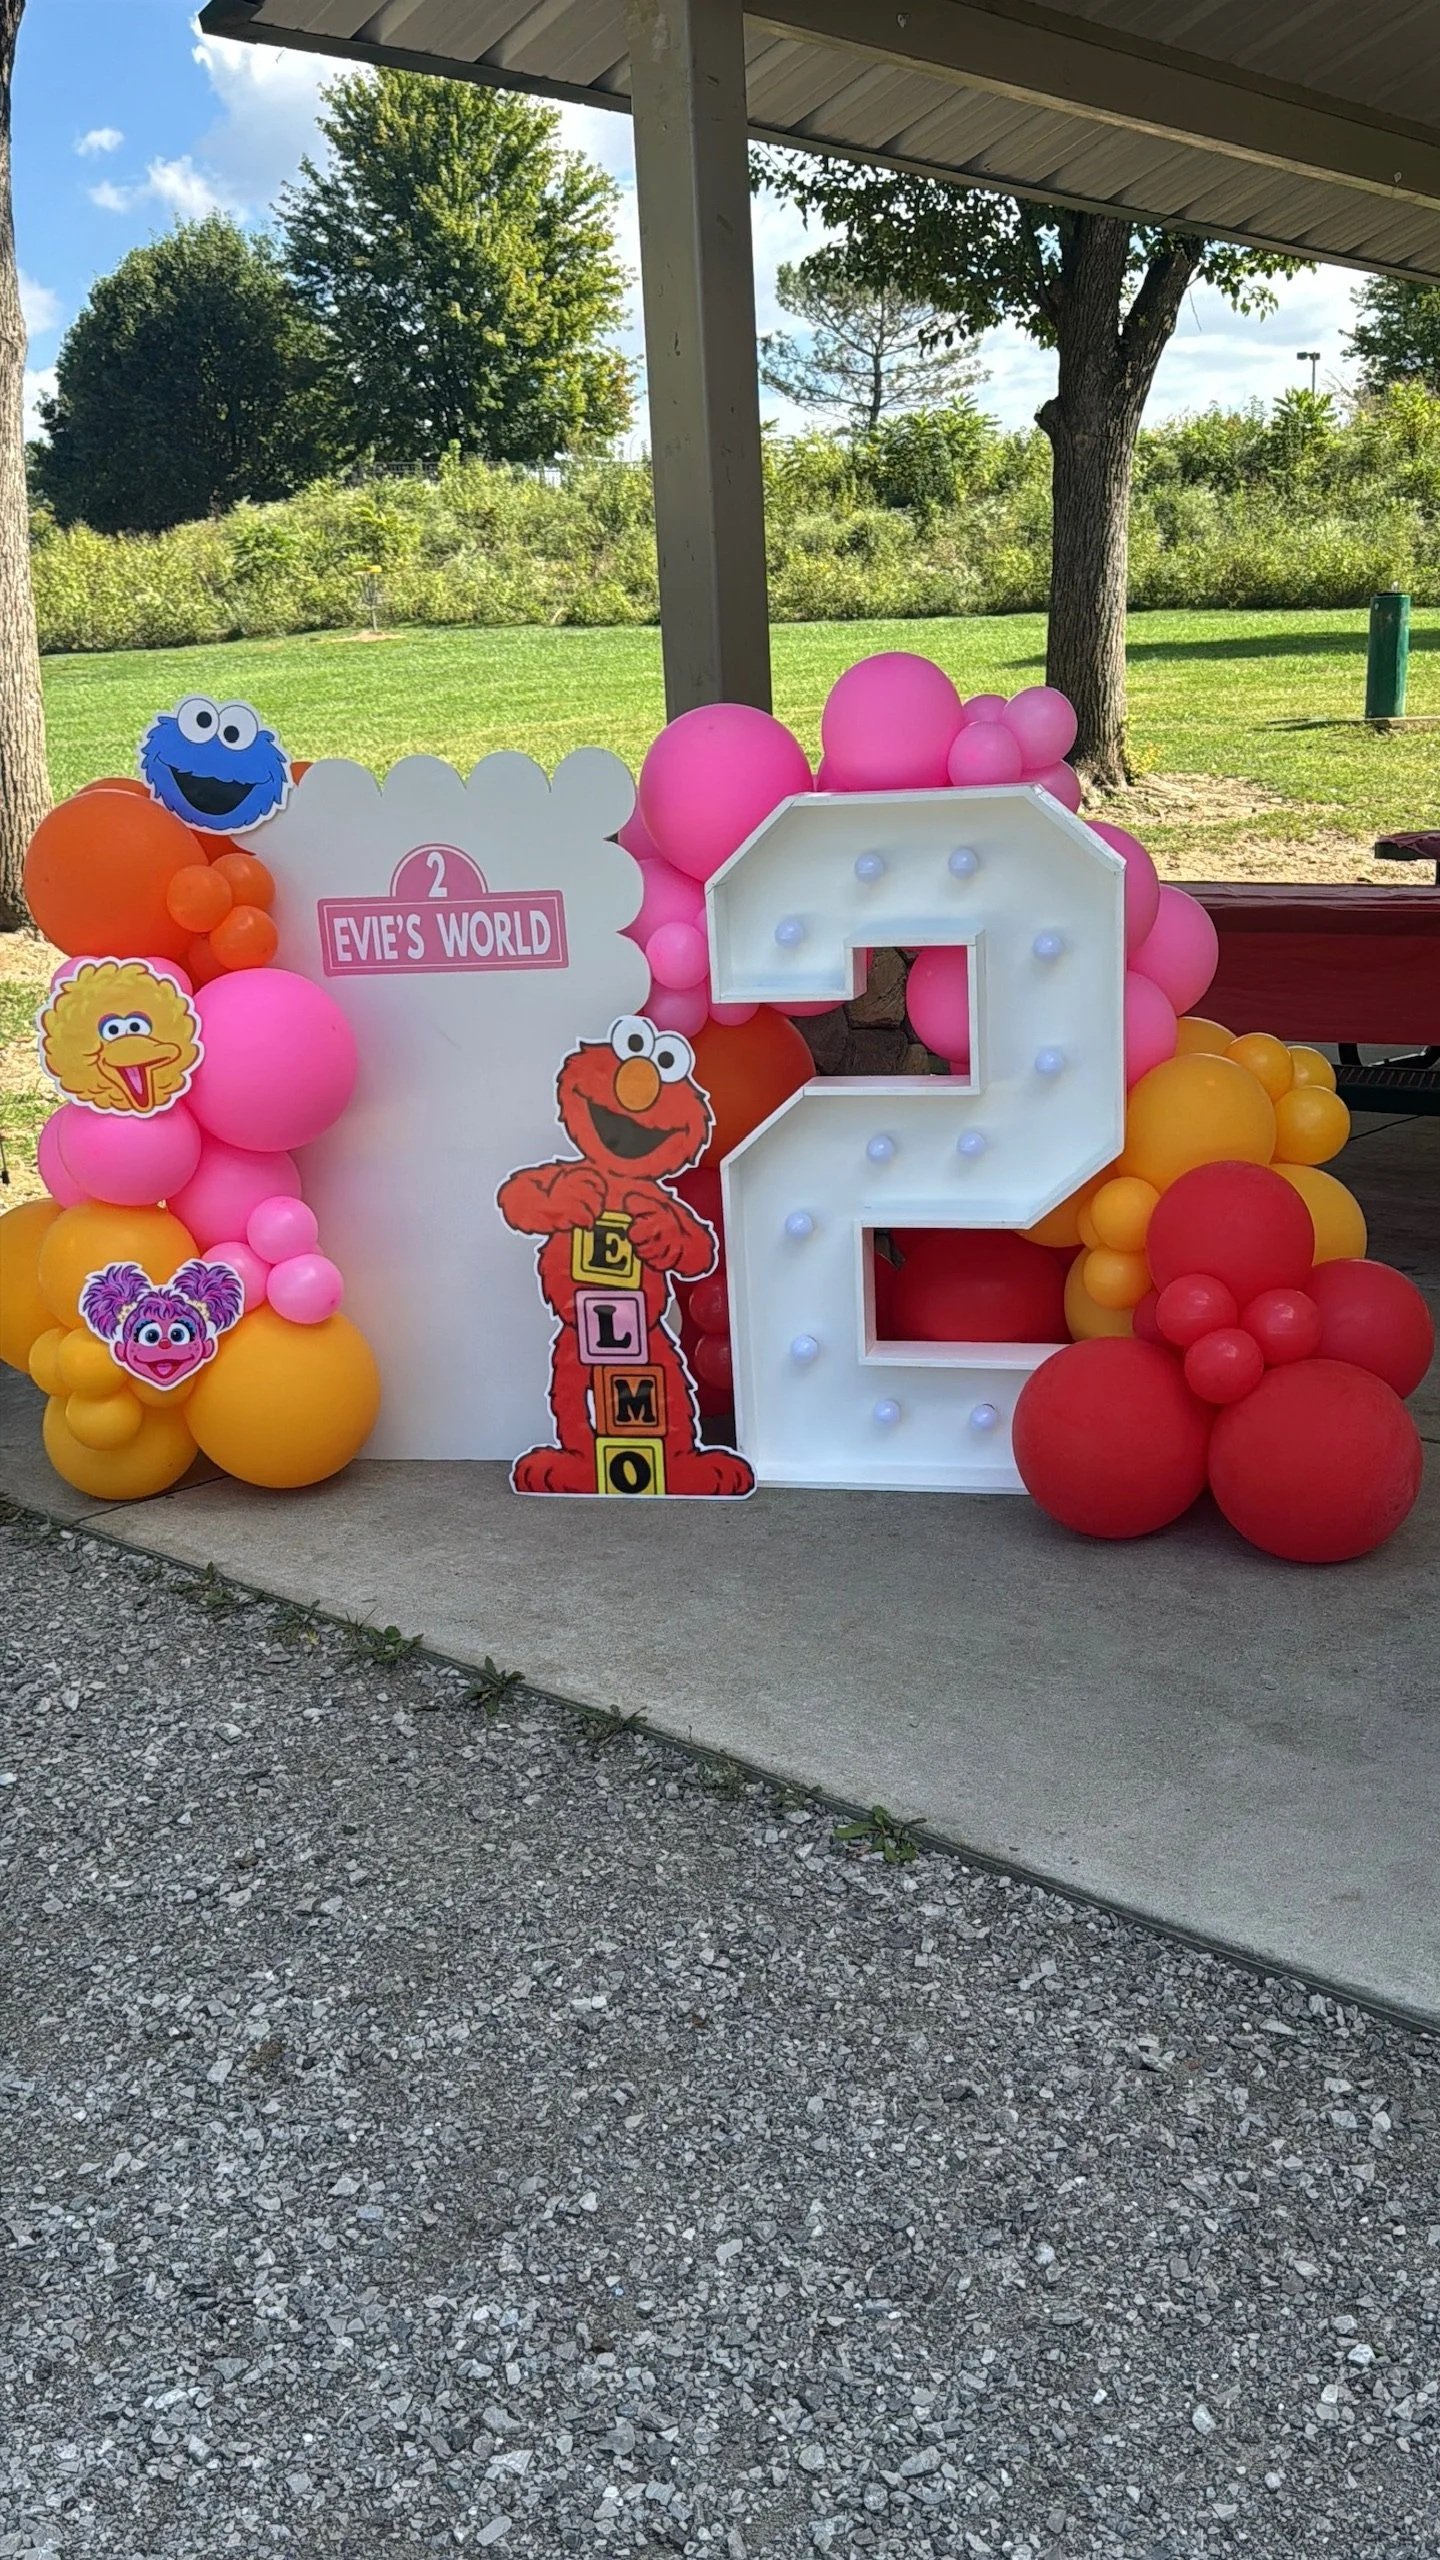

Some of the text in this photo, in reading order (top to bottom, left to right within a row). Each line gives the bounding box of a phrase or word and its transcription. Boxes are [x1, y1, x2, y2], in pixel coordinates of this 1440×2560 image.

[426, 851, 448, 898] 2
[333, 910, 551, 962] EVIE'S WORLD
[705, 784, 1127, 1494] 2
